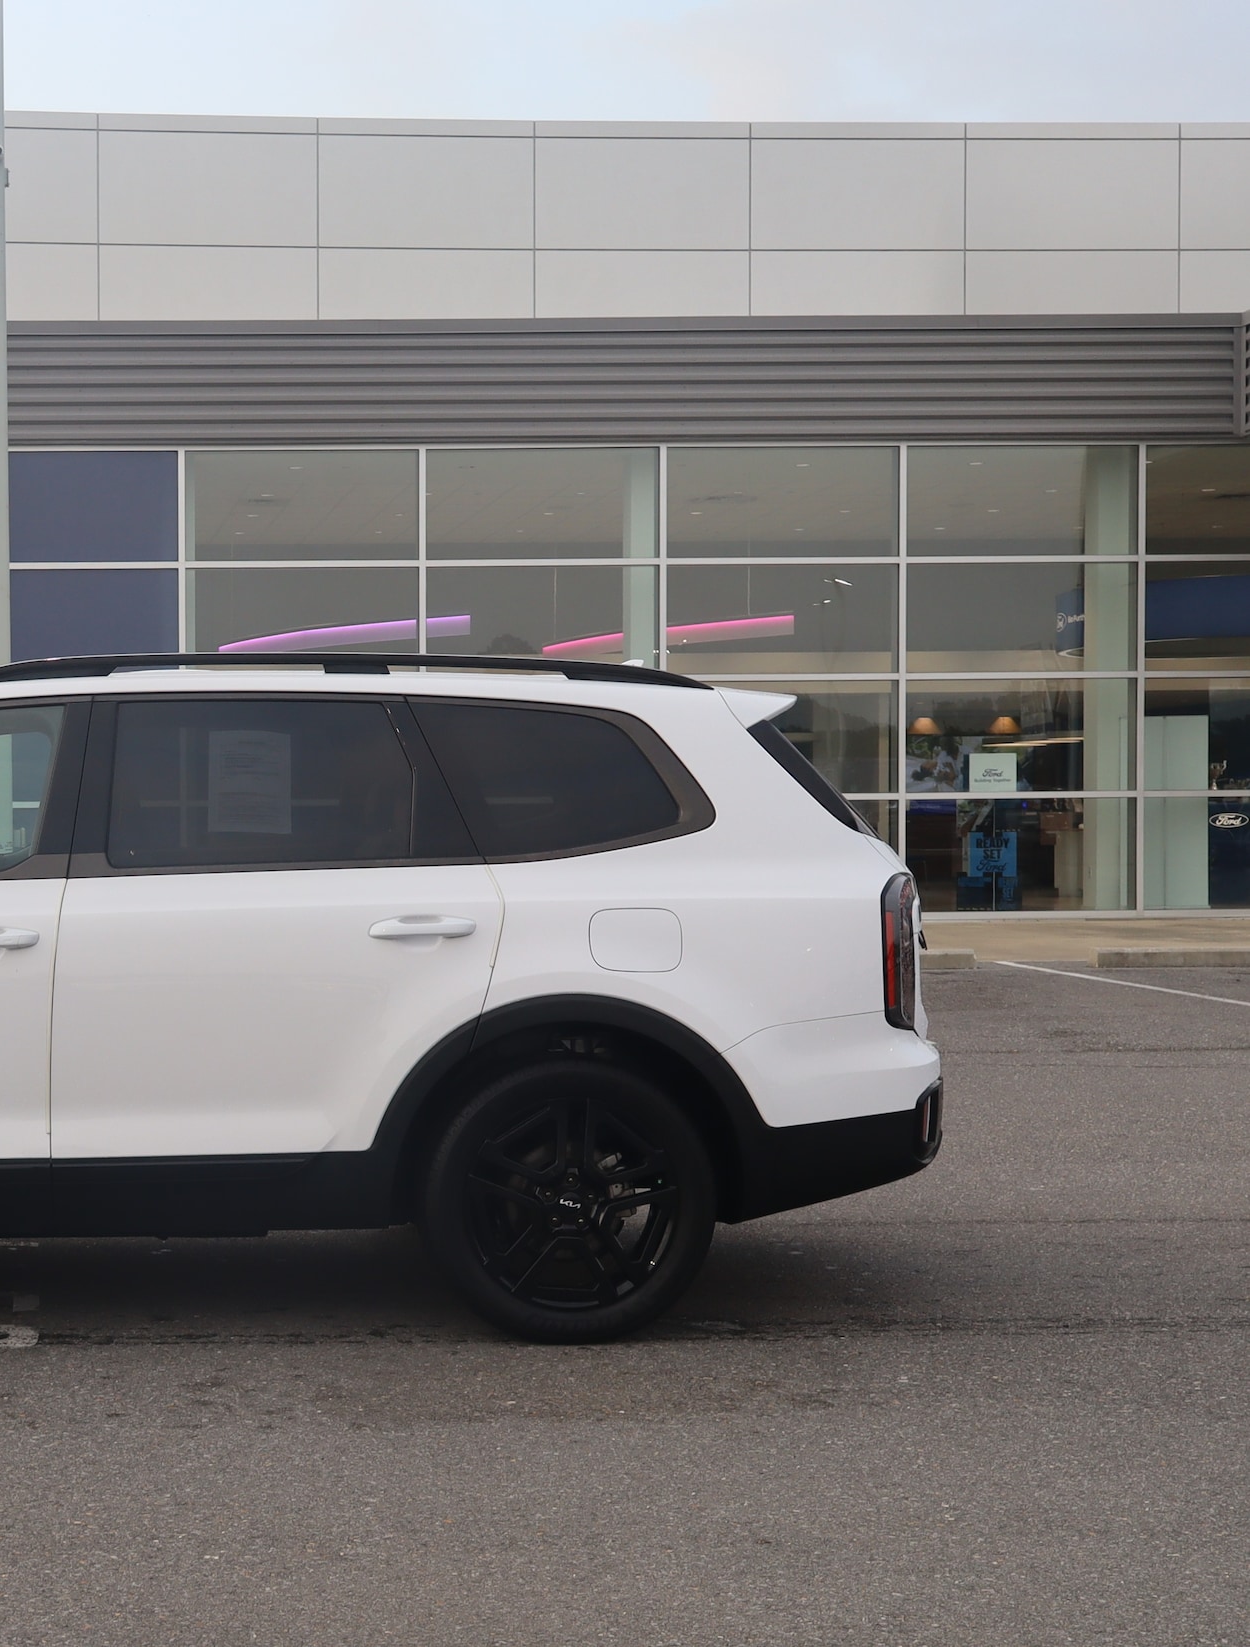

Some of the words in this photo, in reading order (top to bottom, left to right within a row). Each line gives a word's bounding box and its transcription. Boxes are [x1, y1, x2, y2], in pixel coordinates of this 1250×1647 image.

[981, 768, 1004, 777] Ford
[1214, 814, 1244, 826] Ford
[975, 837, 1010, 849] READY
[982, 848, 1002, 859] SET
[976, 859, 1007, 872] Ford
